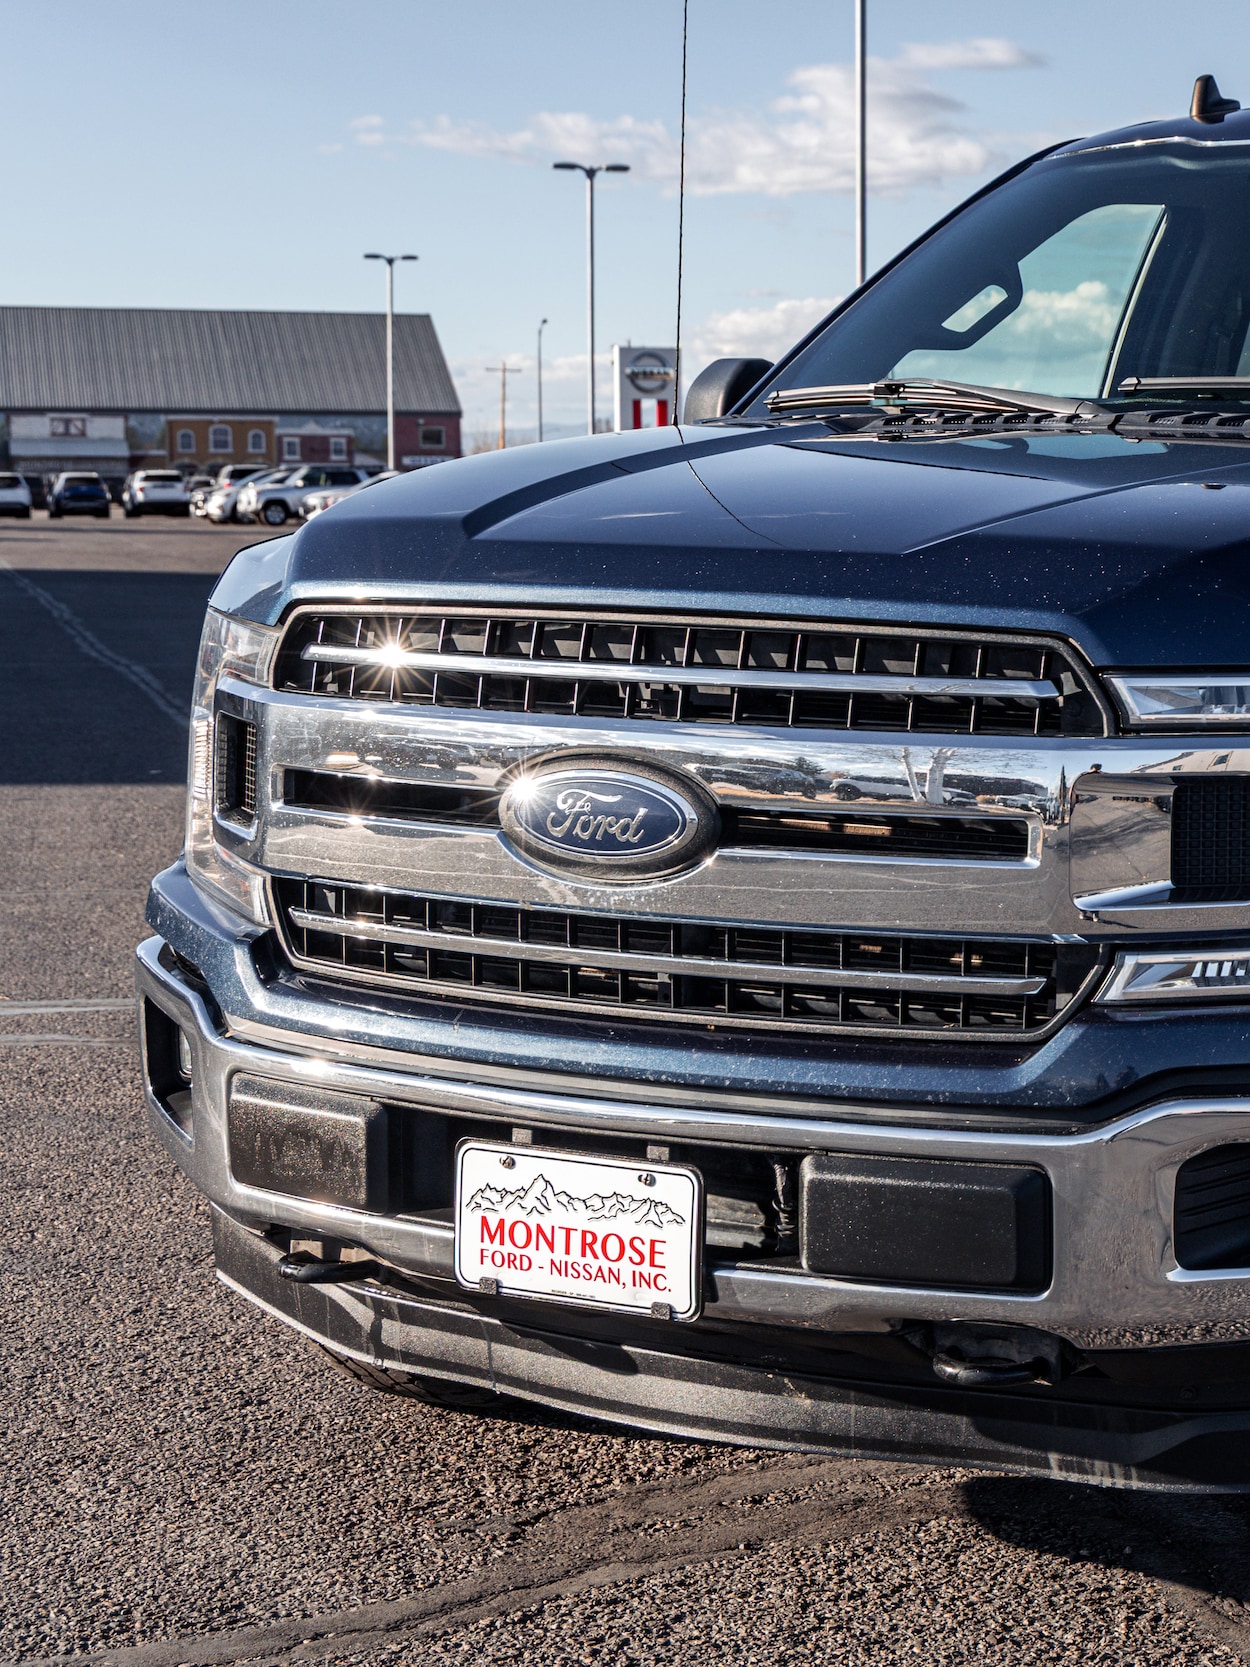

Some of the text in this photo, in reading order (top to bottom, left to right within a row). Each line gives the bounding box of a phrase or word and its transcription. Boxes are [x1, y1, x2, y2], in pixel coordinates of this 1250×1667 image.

[546, 788, 648, 843] Ford
[480, 1215, 666, 1269] MONTROSE
[480, 1248, 532, 1272] FORD
[550, 1258, 626, 1289] NISSAN,
[632, 1270, 672, 1293] INC.
